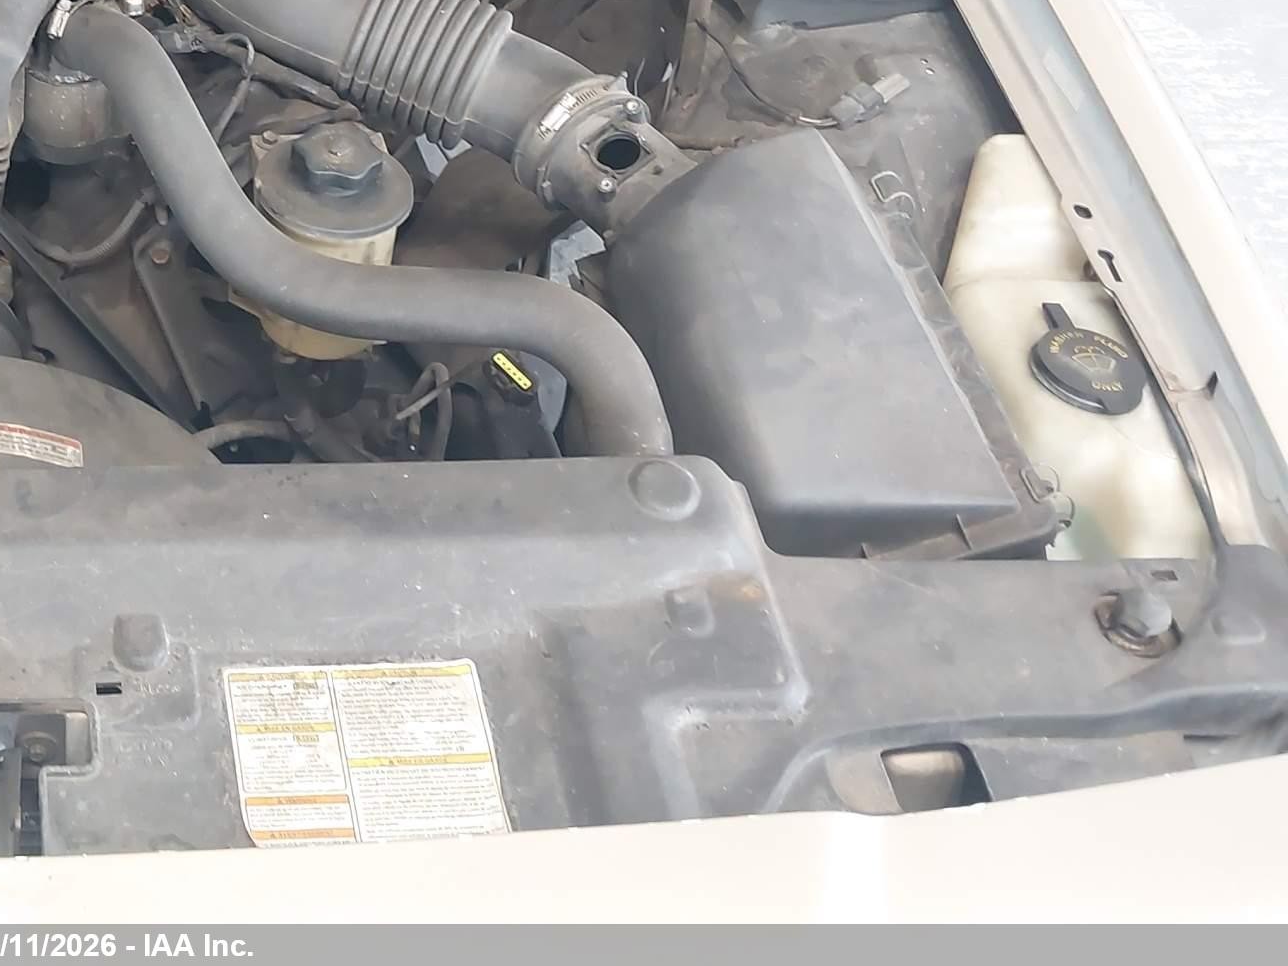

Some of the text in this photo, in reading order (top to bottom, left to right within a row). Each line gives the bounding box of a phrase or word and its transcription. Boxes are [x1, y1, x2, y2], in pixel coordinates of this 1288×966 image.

[1049, 331, 1129, 359] WASHER FLUID
[1091, 380, 1124, 392] ONLY
